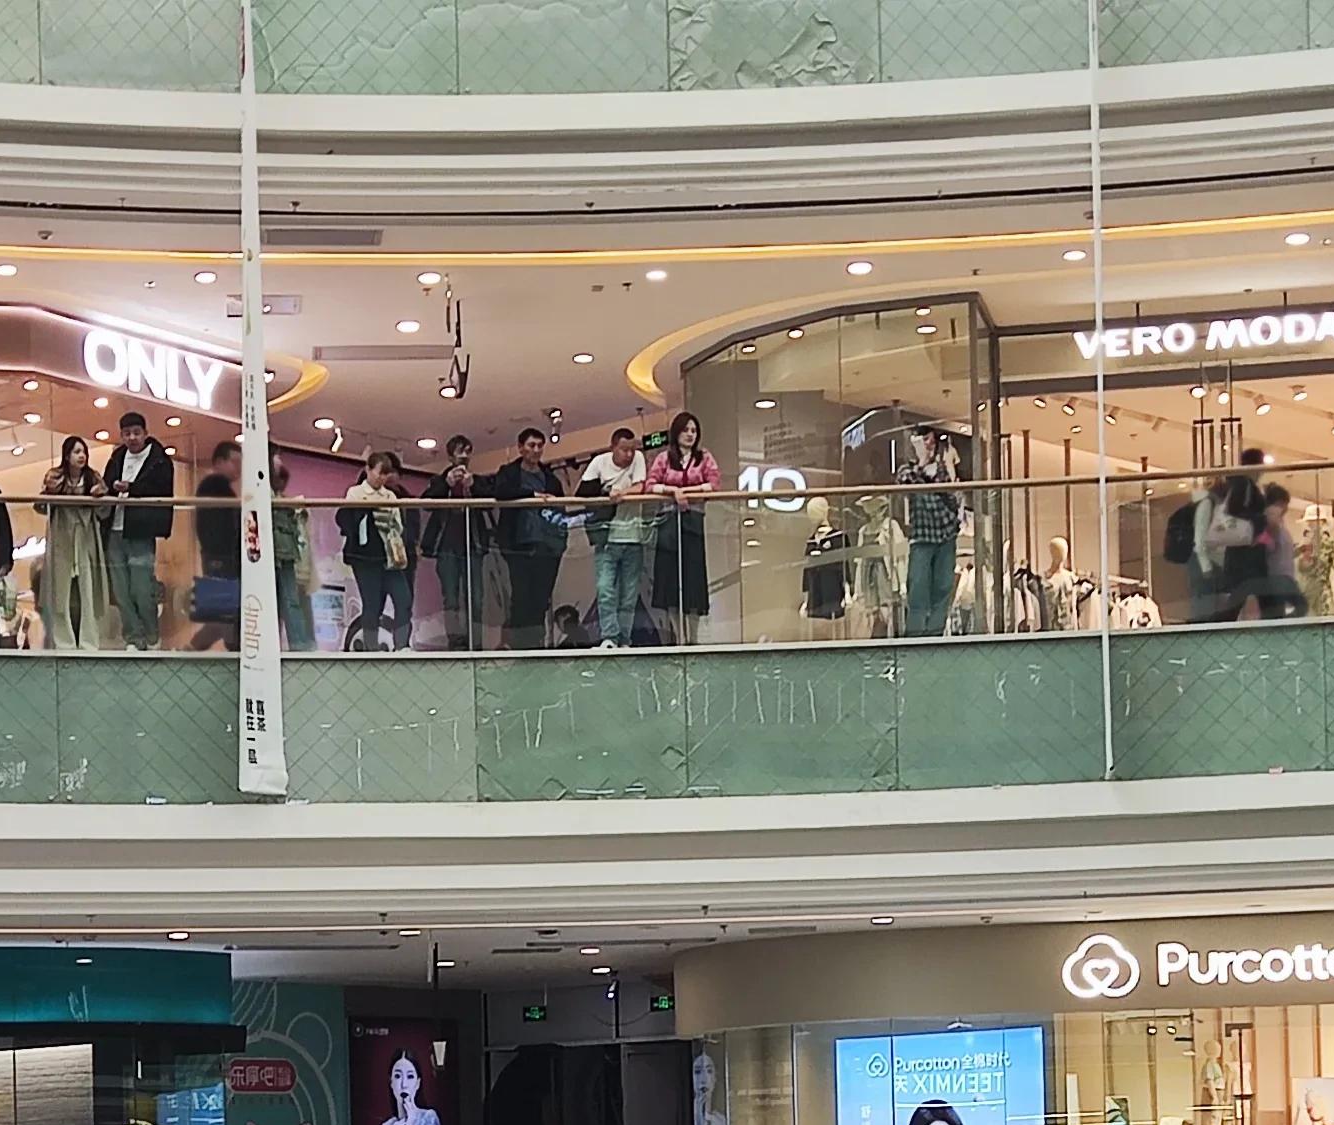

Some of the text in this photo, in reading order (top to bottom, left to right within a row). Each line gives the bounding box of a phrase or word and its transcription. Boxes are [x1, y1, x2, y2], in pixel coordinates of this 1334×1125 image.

[1073, 319, 1196, 361] VERO
[83, 329, 225, 409] ONLY
[893, 1056, 960, 1073] Purcotton
